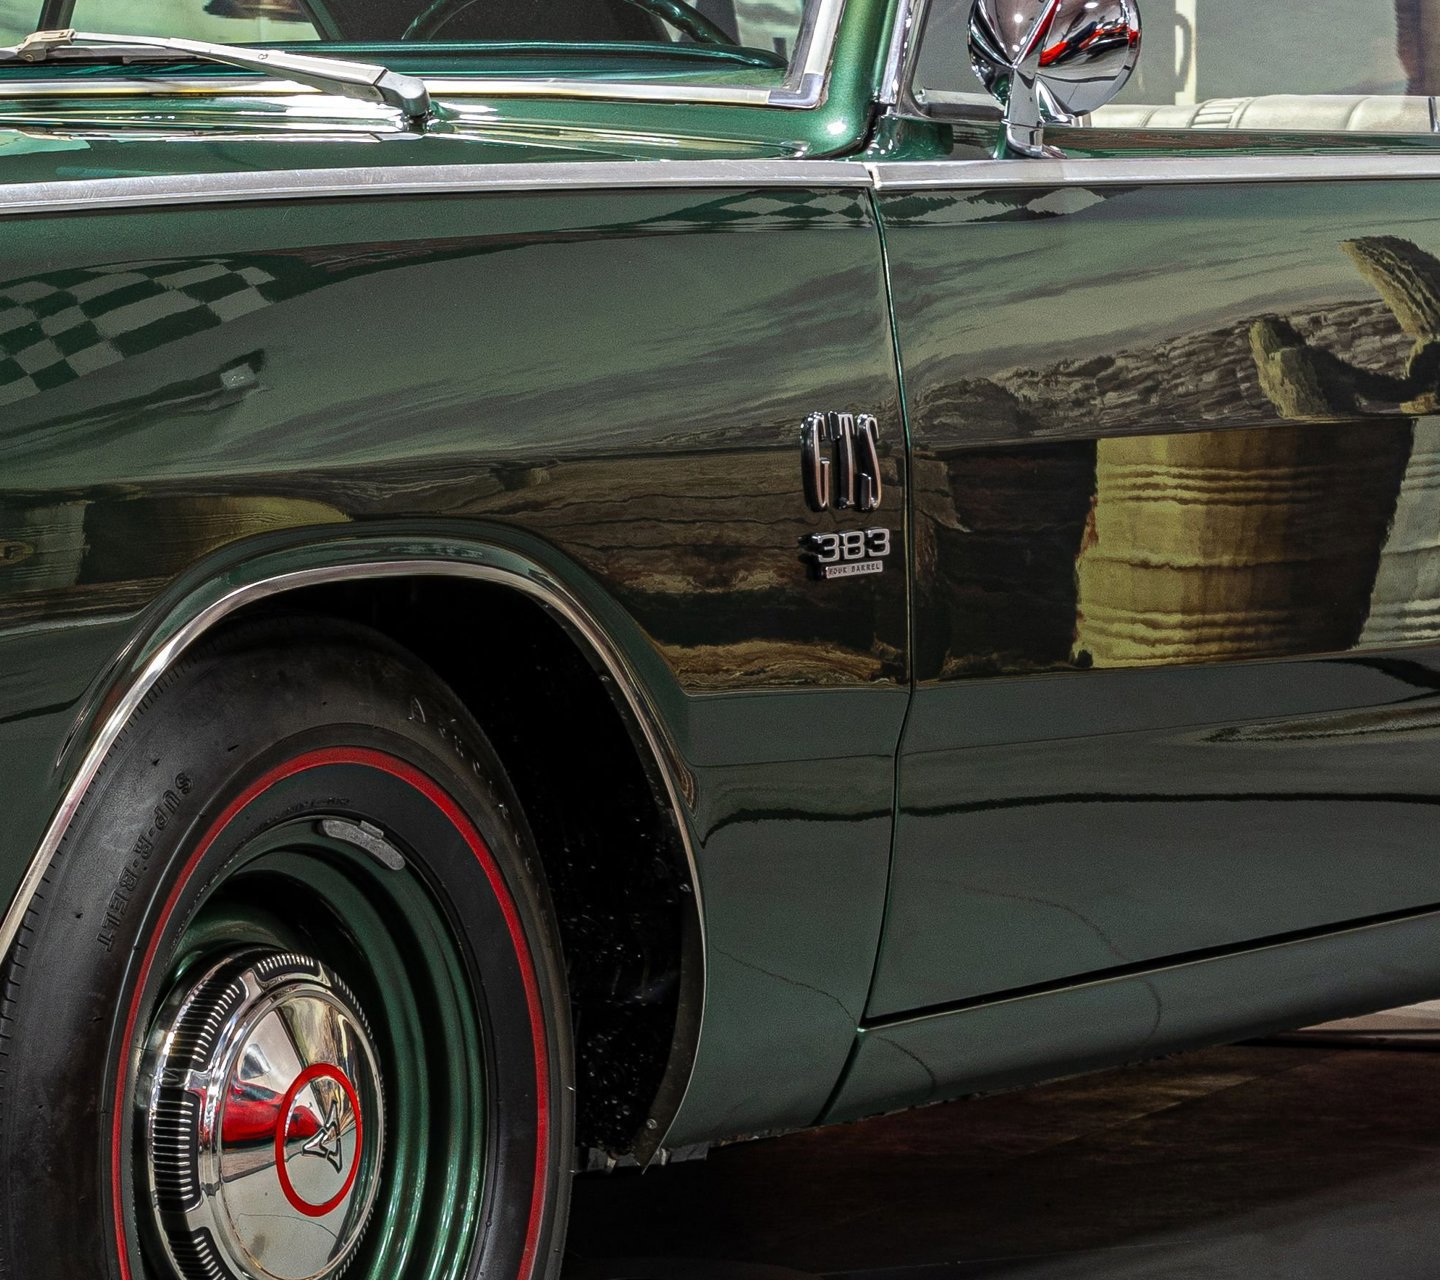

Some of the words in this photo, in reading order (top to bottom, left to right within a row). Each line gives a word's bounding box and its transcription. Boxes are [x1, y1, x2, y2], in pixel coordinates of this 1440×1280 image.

[800, 410, 884, 513] GTS
[812, 527, 891, 563] 383
[851, 562, 880, 574] BARREL
